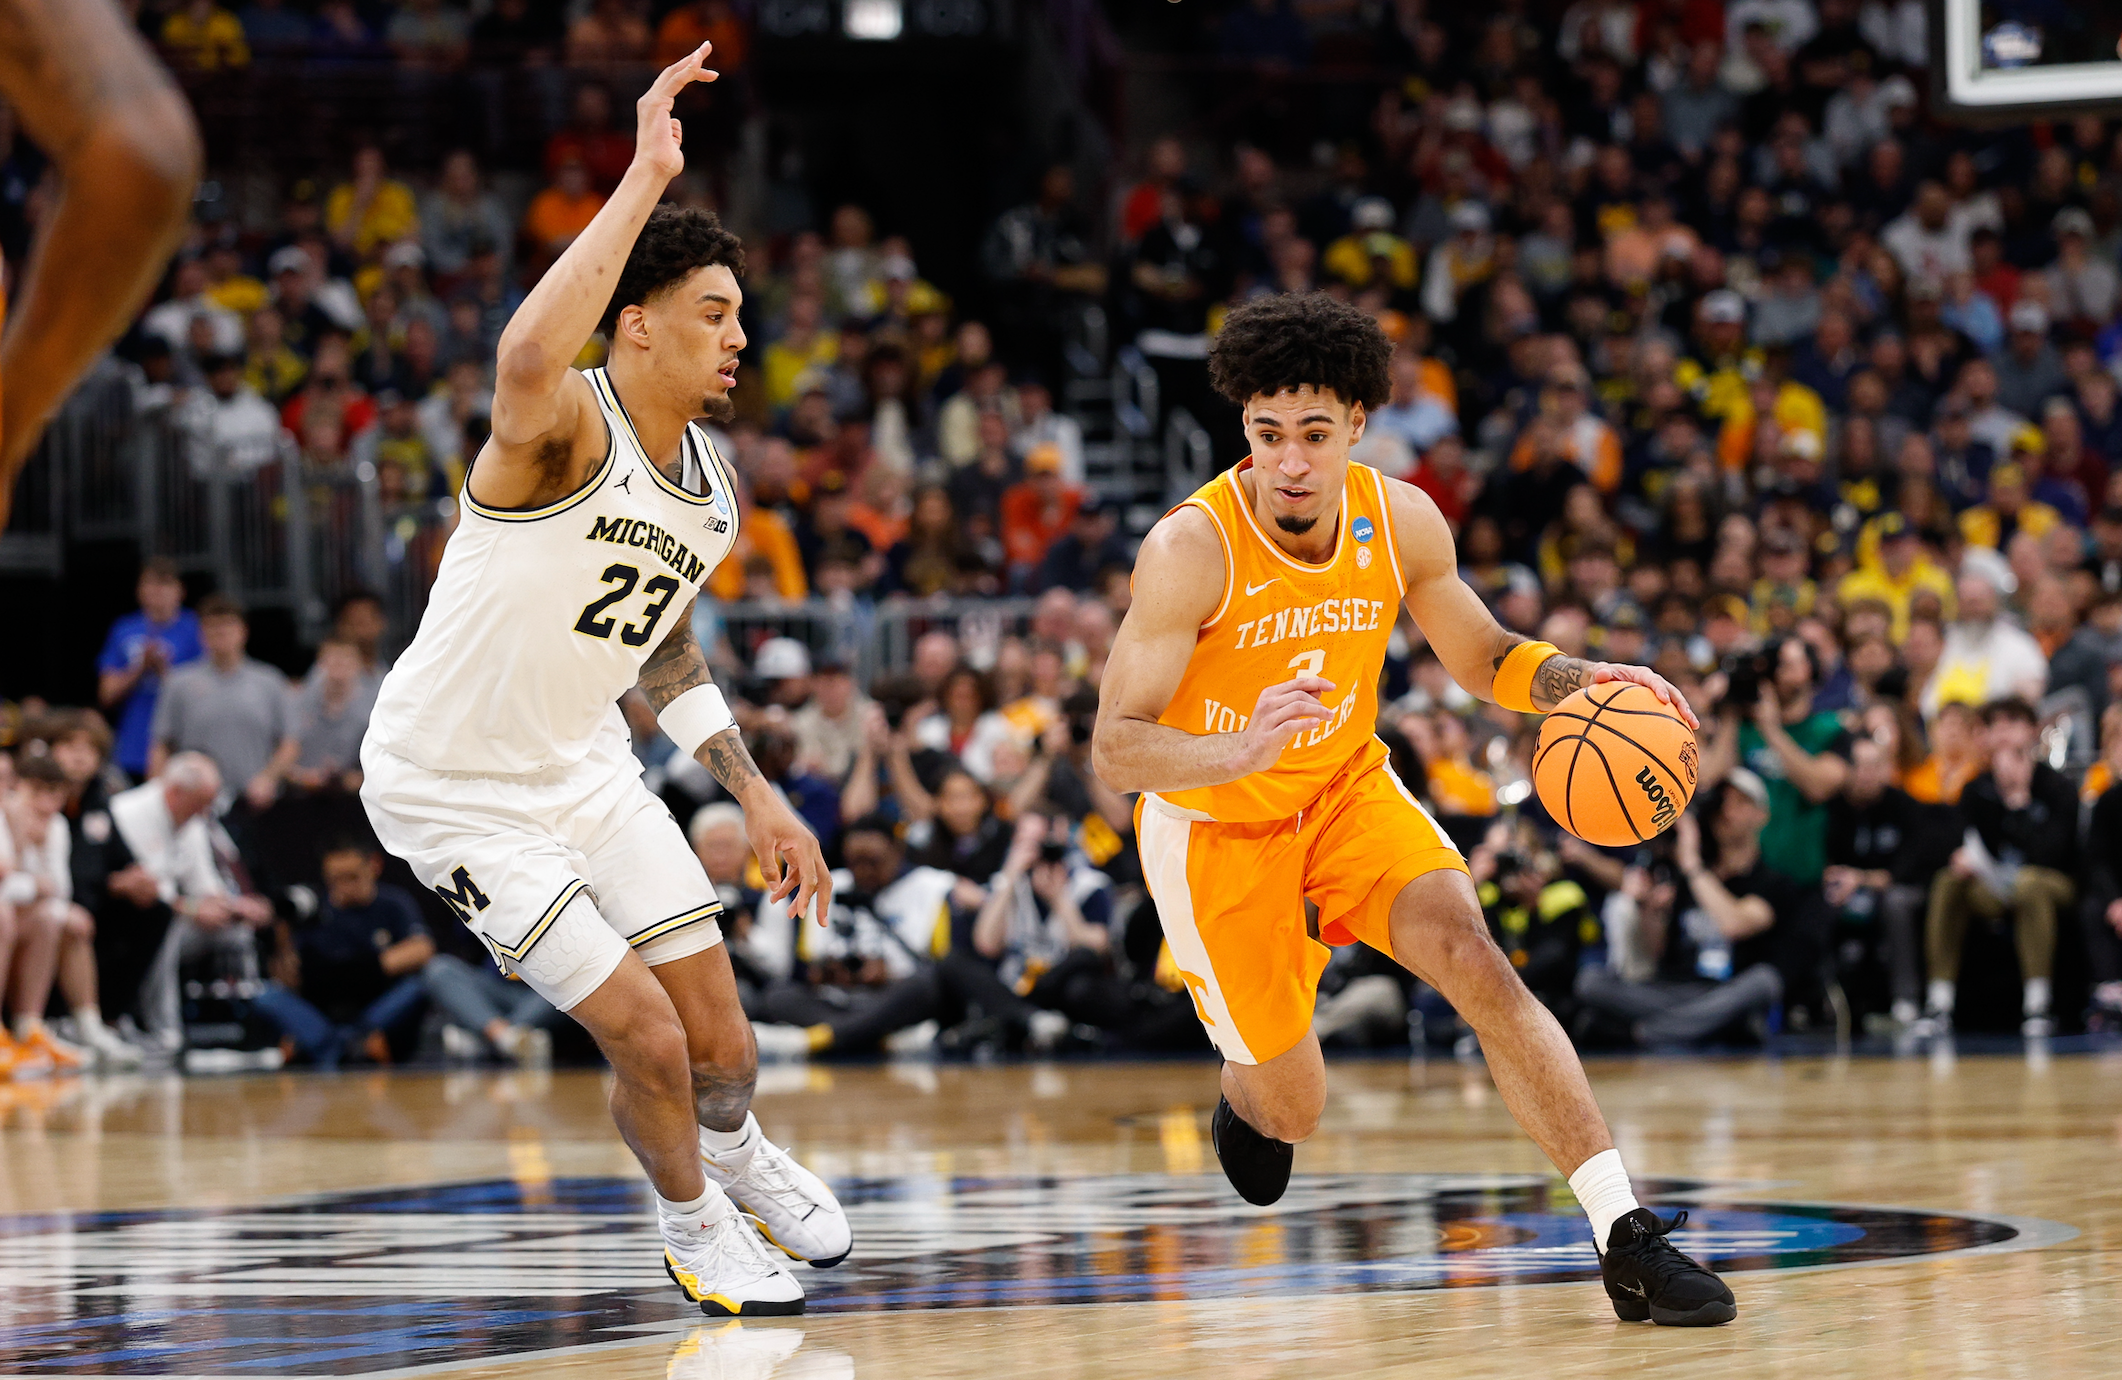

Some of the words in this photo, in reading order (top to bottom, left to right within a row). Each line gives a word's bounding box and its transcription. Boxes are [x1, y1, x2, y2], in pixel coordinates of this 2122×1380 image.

[585, 515, 706, 584] MICHIGAN
[572, 563, 680, 649] 23
[1234, 597, 1384, 650] TENNESSEE
[1204, 679, 1359, 750] VOLTEERS
[1635, 765, 1678, 834] ilson
[435, 864, 492, 925] M
